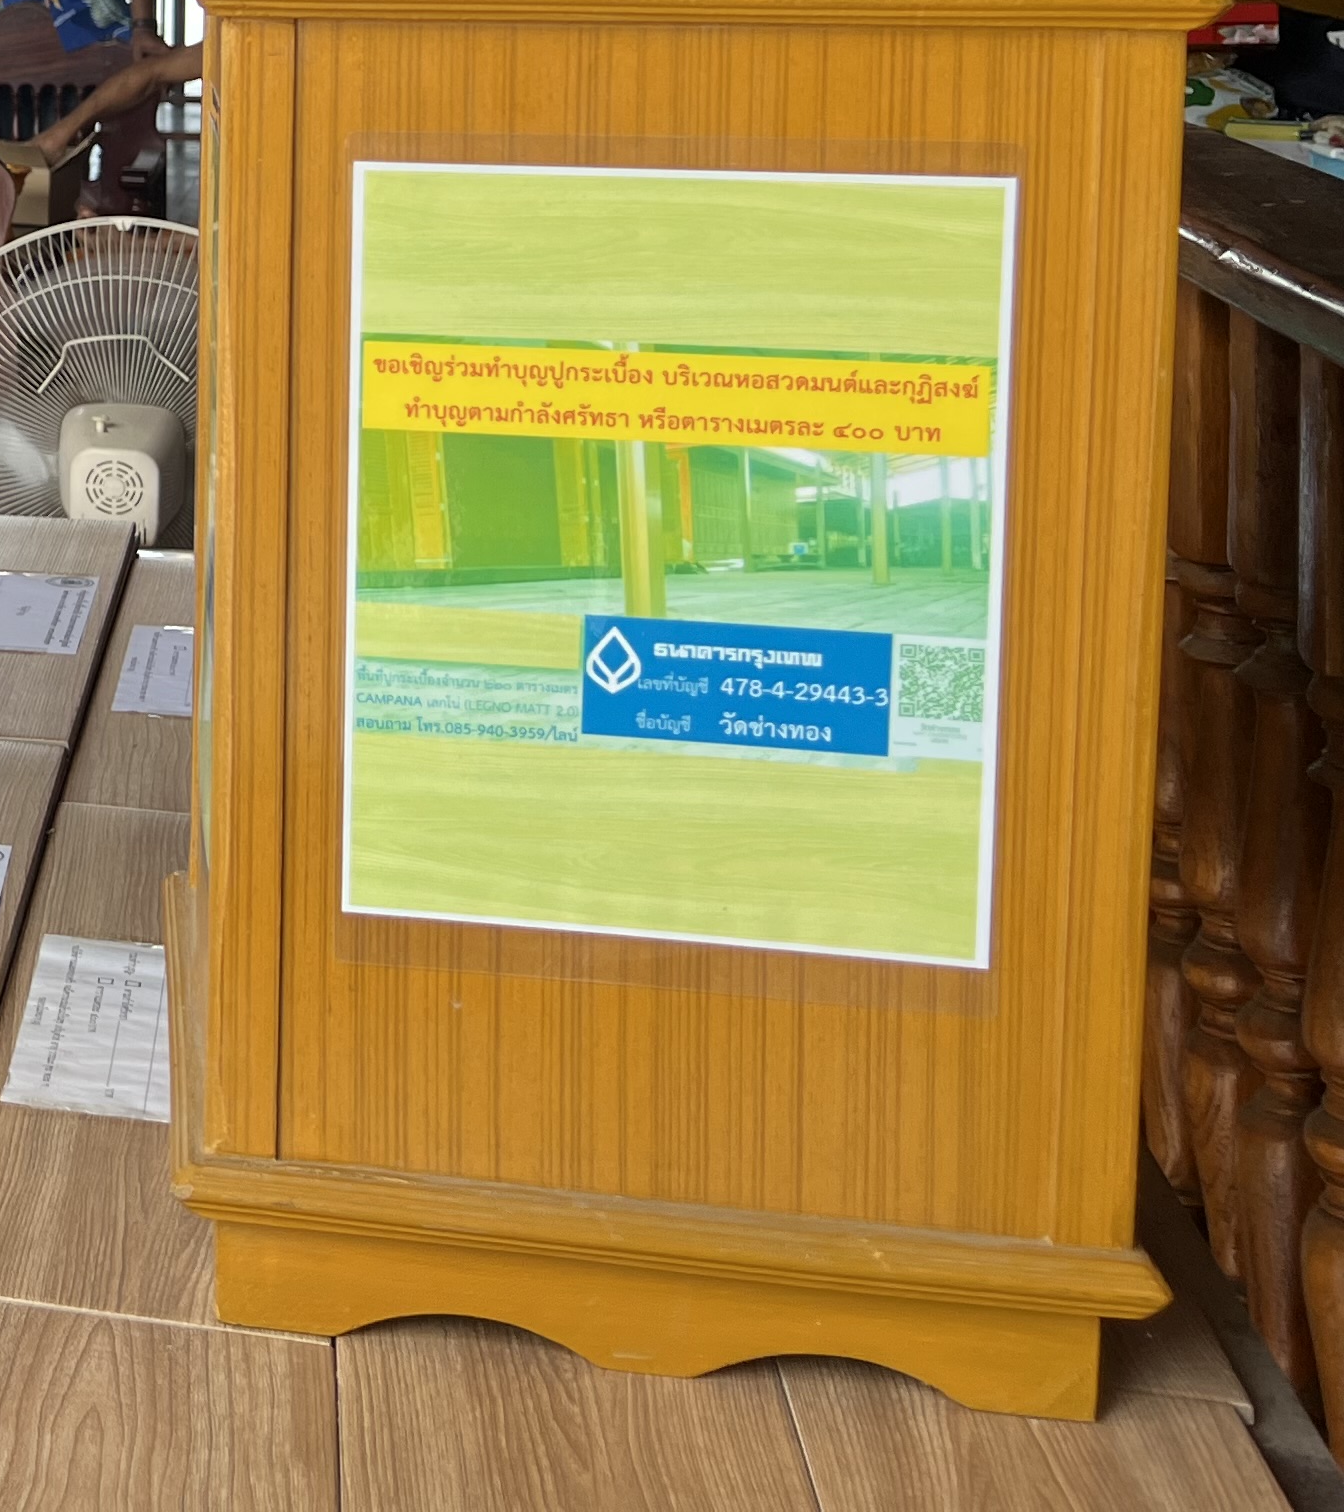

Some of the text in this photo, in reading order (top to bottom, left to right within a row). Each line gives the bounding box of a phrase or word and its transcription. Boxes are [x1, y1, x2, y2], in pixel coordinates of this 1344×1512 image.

[372, 352, 980, 405] ขอเชิญร่วมทำบุญปูกระเบื้อง บริเวณหอสวดมนต์และกุฏิสงฆ์
[404, 395, 942, 443] ทำบุญตามกำลังศรัทธา หรือตารางเมตรละ ๔๐๐ บาท
[653, 642, 823, 669] ธนาคารกรุงเทพ
[356, 692, 422, 708] CAMPANA
[515, 702, 551, 716] MATT
[637, 671, 889, 707] เลขที่บัญชี 478-4-29443-3
[356, 717, 412, 731] สอบถาม
[635, 708, 832, 743] ชื่อบัญชี วัดช่างทอง
